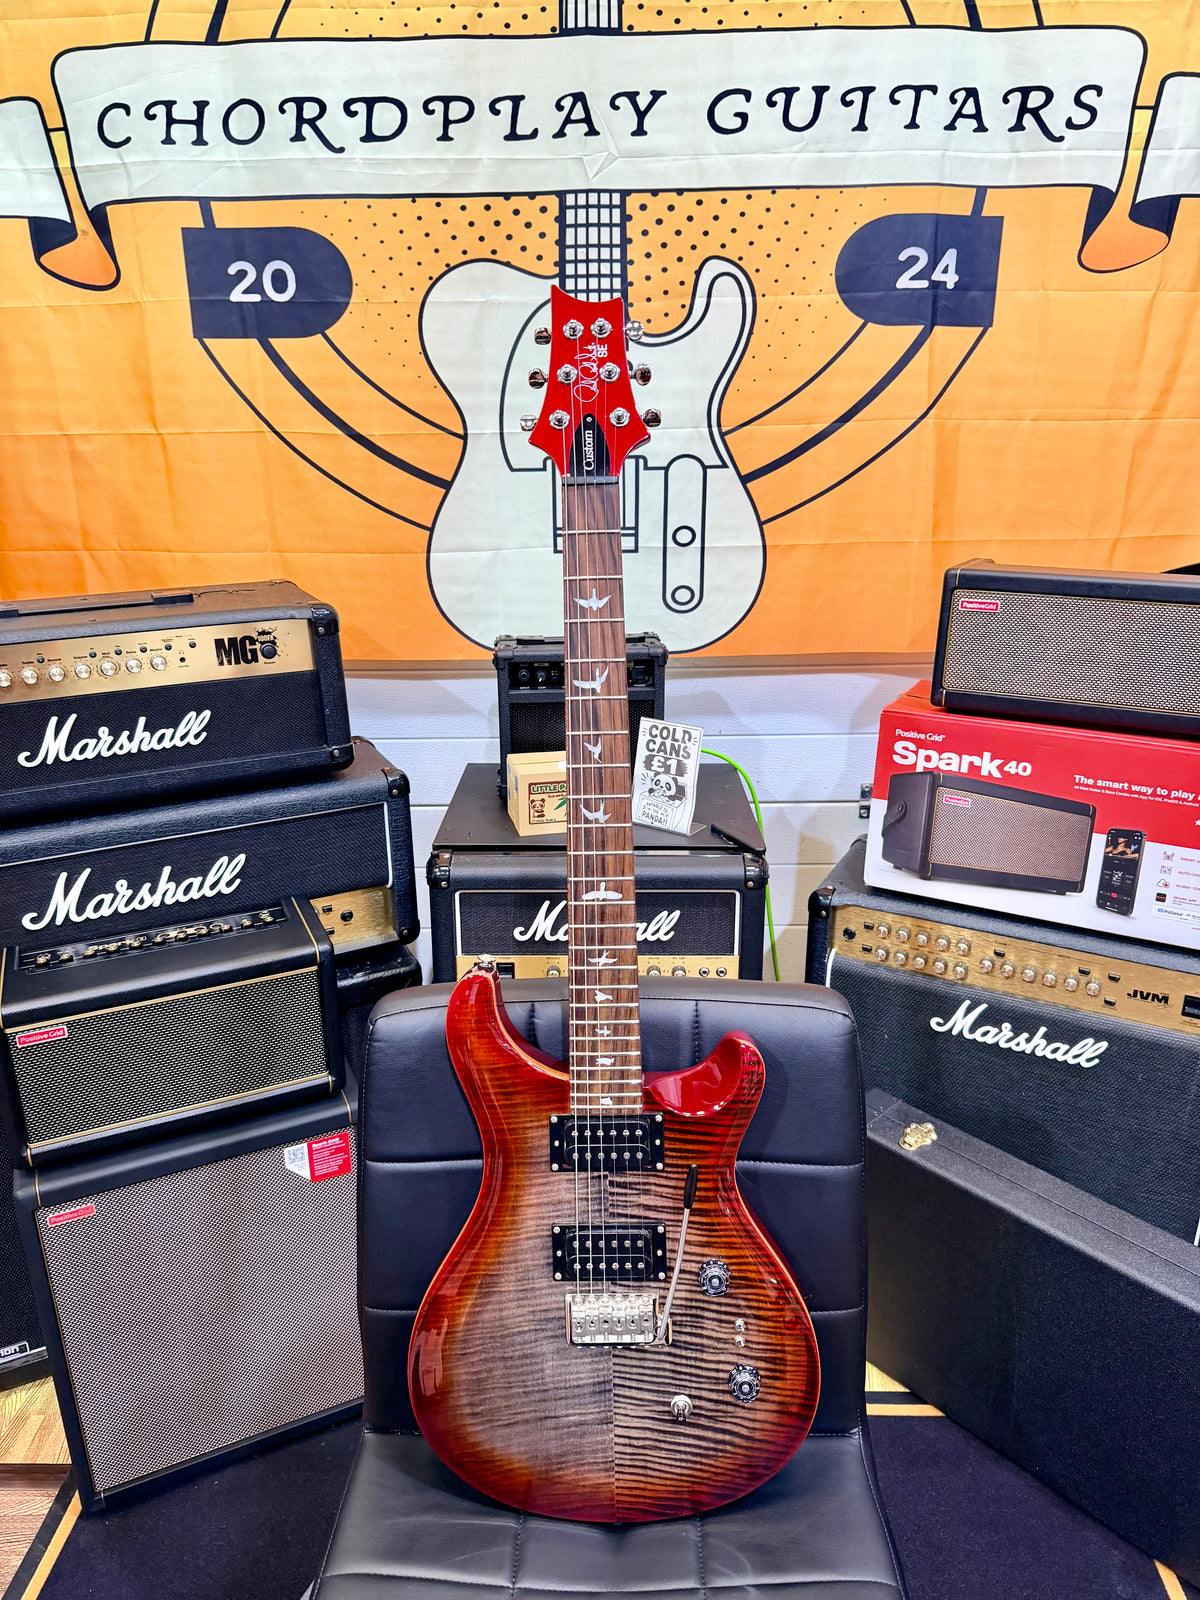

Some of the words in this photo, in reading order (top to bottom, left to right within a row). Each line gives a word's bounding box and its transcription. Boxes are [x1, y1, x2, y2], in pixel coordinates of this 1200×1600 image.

[97, 90, 667, 154] CHORDPLAY
[706, 84, 1103, 142] GUITARS
[227, 260, 297, 303] 20
[897, 246, 960, 290] 24
[597, 343, 608, 358] SE
[583, 429, 594, 471] Custom
[214, 635, 259, 667] MG
[17, 709, 212, 768] Marshall
[645, 738, 691, 760] CANS
[648, 724, 693, 745] COLD
[896, 729, 926, 740] Positive
[651, 756, 677, 775] £1
[892, 740, 1004, 778] Spark
[1003, 760, 1032, 777] 40
[532, 784, 558, 793] LITTLE
[1074, 774, 1094, 785] The
[1096, 779, 1129, 790] smart
[1131, 784, 1154, 795] way
[1156, 787, 1168, 796] to
[1170, 789, 1195, 801] play
[21, 853, 247, 931] Marshall
[1126, 989, 1170, 1006] JVM
[20, 1034, 48, 1044] Positive
[929, 999, 1109, 1069] Marshall
